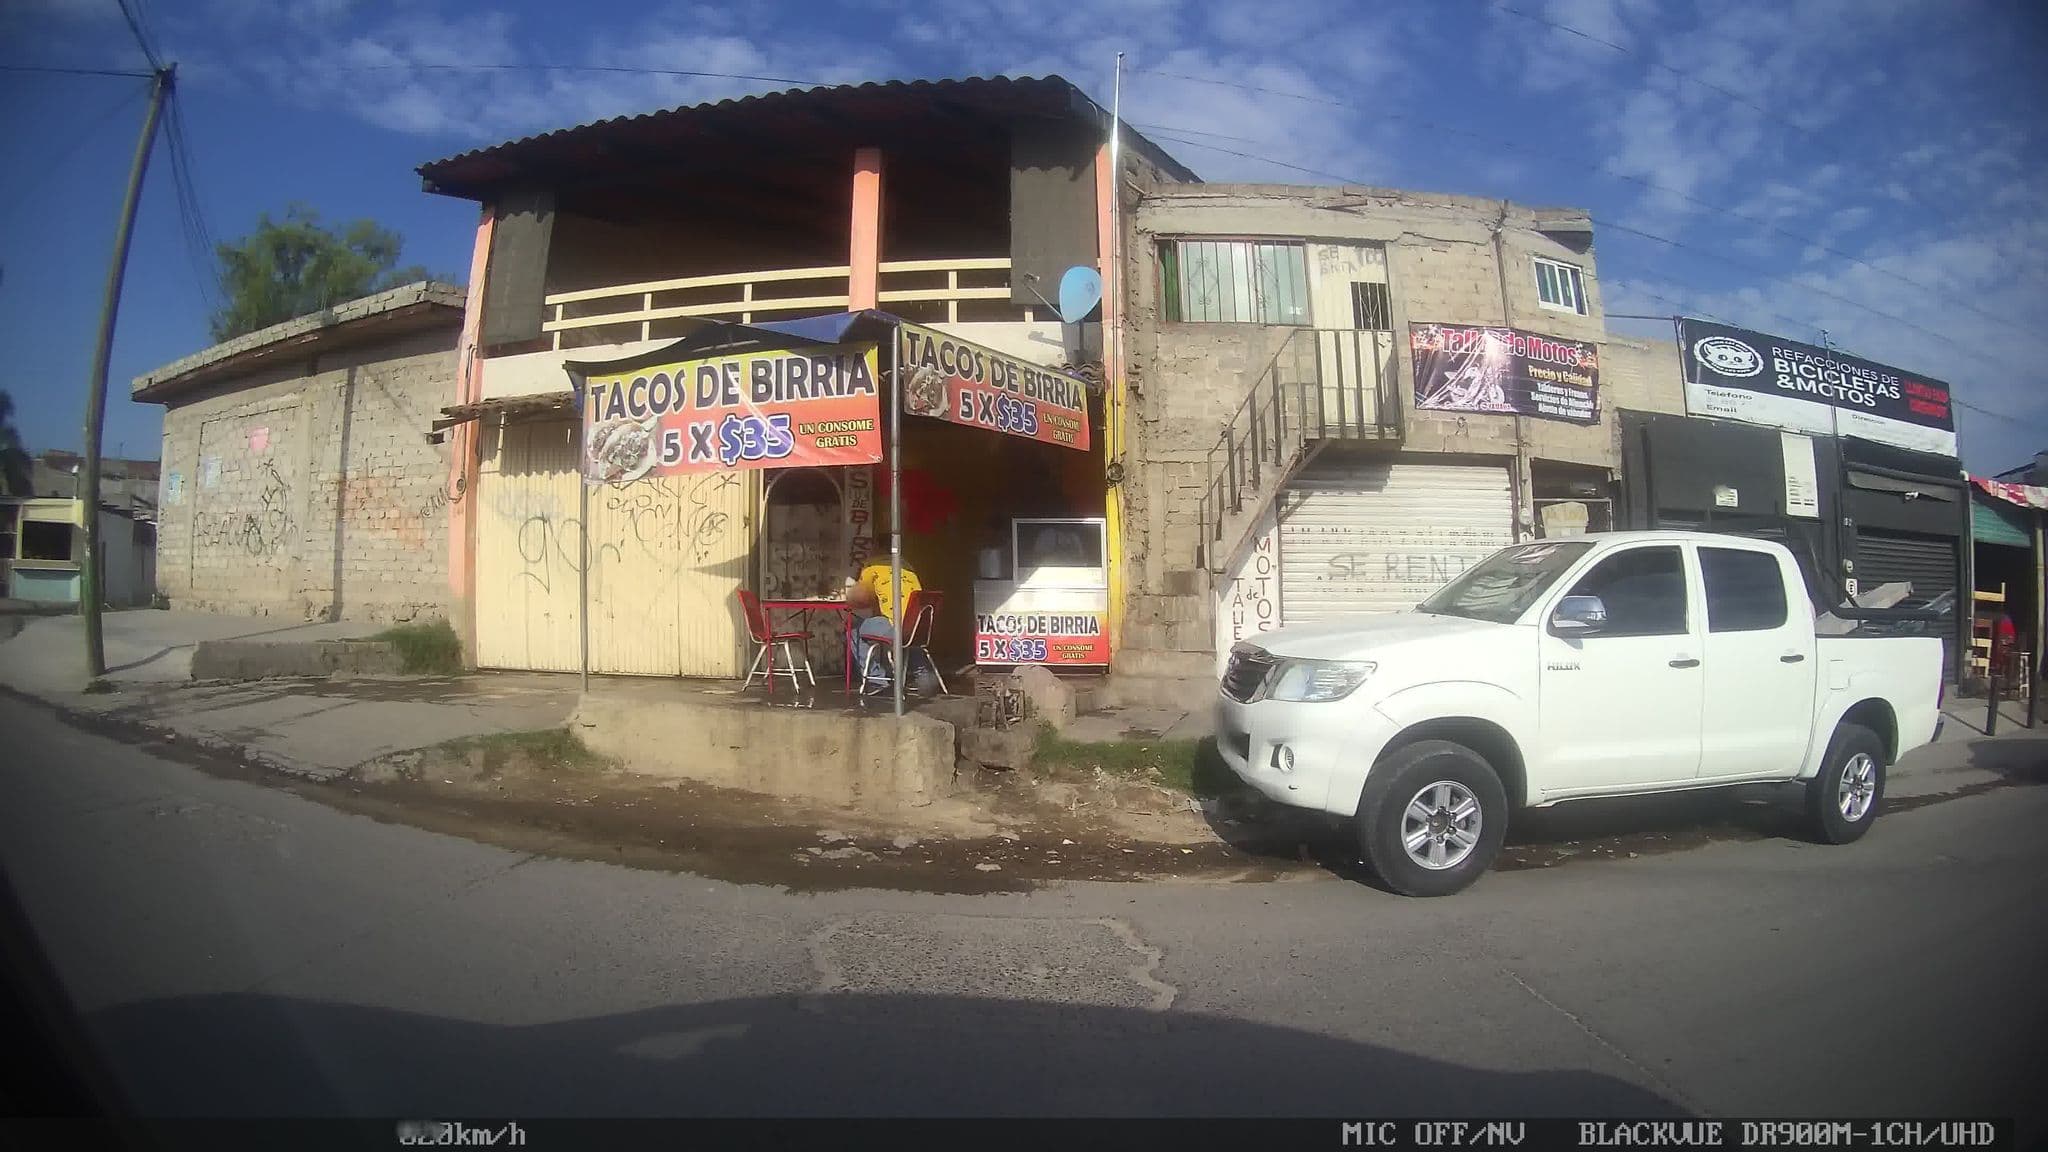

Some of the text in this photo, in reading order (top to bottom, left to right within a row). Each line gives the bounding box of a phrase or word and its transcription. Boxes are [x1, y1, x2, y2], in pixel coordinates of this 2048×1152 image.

[1441, 327, 1494, 354] Tall
[1527, 336, 1579, 367] Motos
[907, 331, 1083, 412] TACOS DE BIRRIA
[1528, 365, 1557, 380] Precio
[1556, 371, 1562, 382] y
[1772, 347, 1878, 380] REFACCIONES
[1881, 374, 1899, 386] DE
[1774, 358, 1900, 399] BICICLETAS
[591, 353, 876, 422] TACOS DE BIRRIA
[1777, 374, 1876, 407] &MOTOS
[799, 419, 874, 435] UN CONSOME
[960, 391, 1038, 435] 5 X $35
[663, 414, 794, 465] 5 X $35
[815, 435, 857, 447] GRATIS
[1052, 430, 1074, 443] GRATIS
[1328, 552, 1478, 582] SE RENT
[977, 615, 1099, 634] TACOS DE BIRRIA
[1231, 577, 1246, 641] TALLE
[979, 639, 1047, 661] 5 X $35
